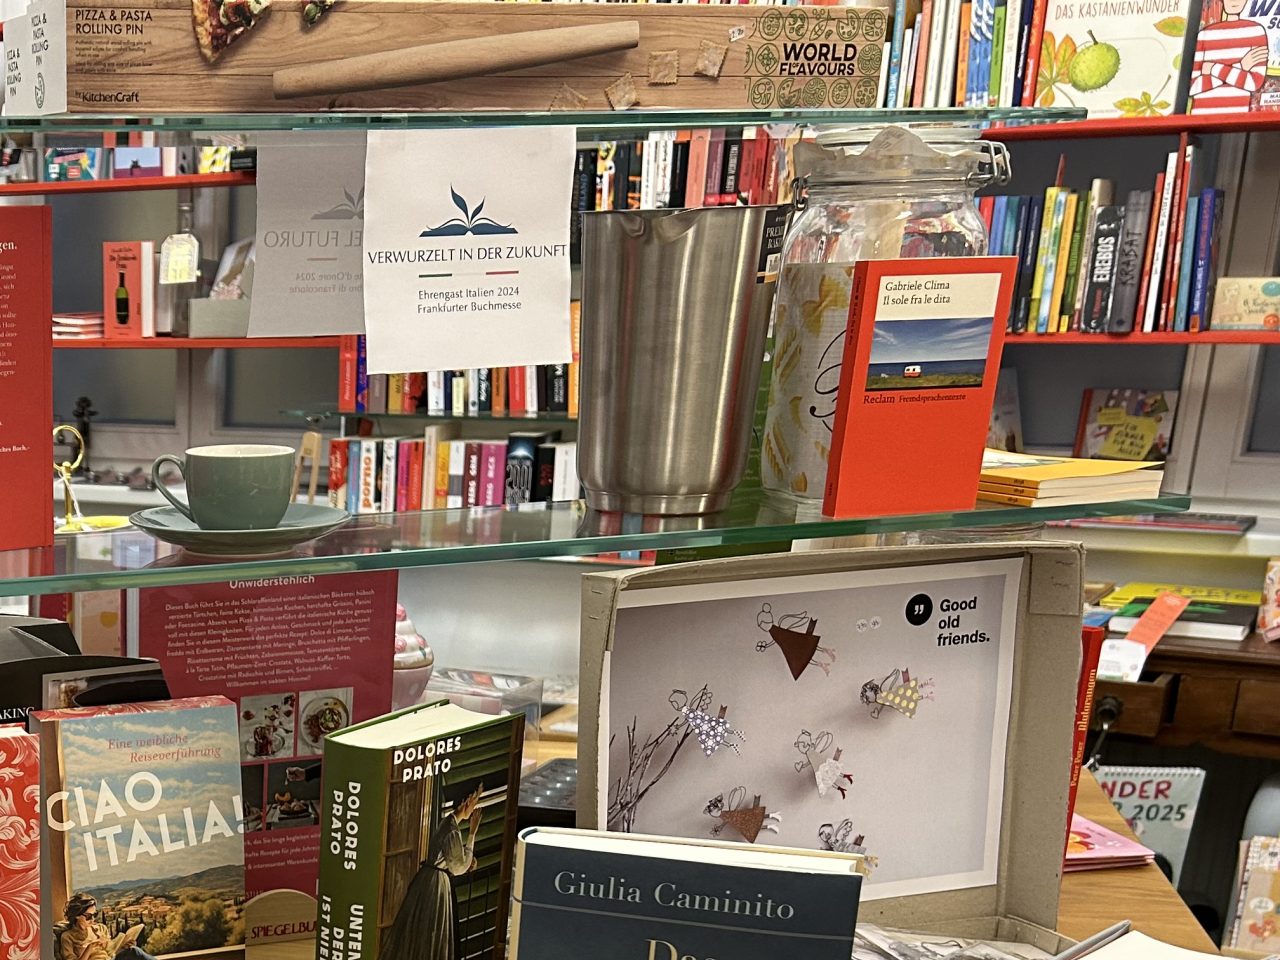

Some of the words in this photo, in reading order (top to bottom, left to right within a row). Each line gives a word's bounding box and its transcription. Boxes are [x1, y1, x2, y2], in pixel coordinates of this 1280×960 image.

[75, 10, 106, 21] PIZZA
[109, 10, 117, 21] &
[120, 10, 153, 21] PASTA
[1055, 4, 1073, 21] DAS
[1078, 0, 1180, 18] KASTANIENWUNDER
[75, 23, 122, 35] ROLLING
[125, 23, 144, 35] PIN
[783, 43, 858, 62] WORLD
[779, 62, 855, 76] FLAVOURS
[82, 90, 139, 102] KitchenCraft
[368, 249, 455, 264] VERWURZELT
[459, 248, 473, 261] IN
[477, 247, 502, 260] DER
[506, 244, 567, 259] ZUKUNFT
[1093, 236, 1116, 282] EREBOS
[418, 289, 463, 302] Ehrengast
[465, 288, 495, 298] Italien
[497, 286, 520, 297] 2024
[885, 280, 922, 291] Gabriele
[923, 280, 950, 291] Clima
[417, 303, 468, 314] Frankfurter
[470, 301, 522, 312] Buchmesse
[883, 296, 890, 305] Il
[891, 295, 909, 305] sole
[910, 295, 923, 306] fra
[924, 294, 933, 304] le
[933, 294, 951, 304] dita
[863, 394, 895, 404] Reclam
[898, 392, 966, 404] Fremdsprachentexte
[361, 456, 372, 508] porno
[228, 574, 315, 589] Unwiderstehlich
[939, 595, 978, 613] Good
[938, 615, 961, 629] old
[936, 630, 991, 647] friends.
[108, 737, 133, 750] Eine
[135, 733, 189, 748] weibliche
[393, 736, 462, 765] DOLORES
[129, 746, 222, 764] Reiseverführung
[402, 758, 452, 783] PRATO
[46, 771, 163, 832] CIAO
[1131, 803, 1188, 821] 2025
[330, 789, 344, 856] PRATO
[343, 781, 361, 871] DOLORES
[82, 795, 245, 872] ITALIA!
[554, 871, 642, 903] Giulia
[654, 882, 795, 920] Caminito
[321, 895, 332, 924] IST
